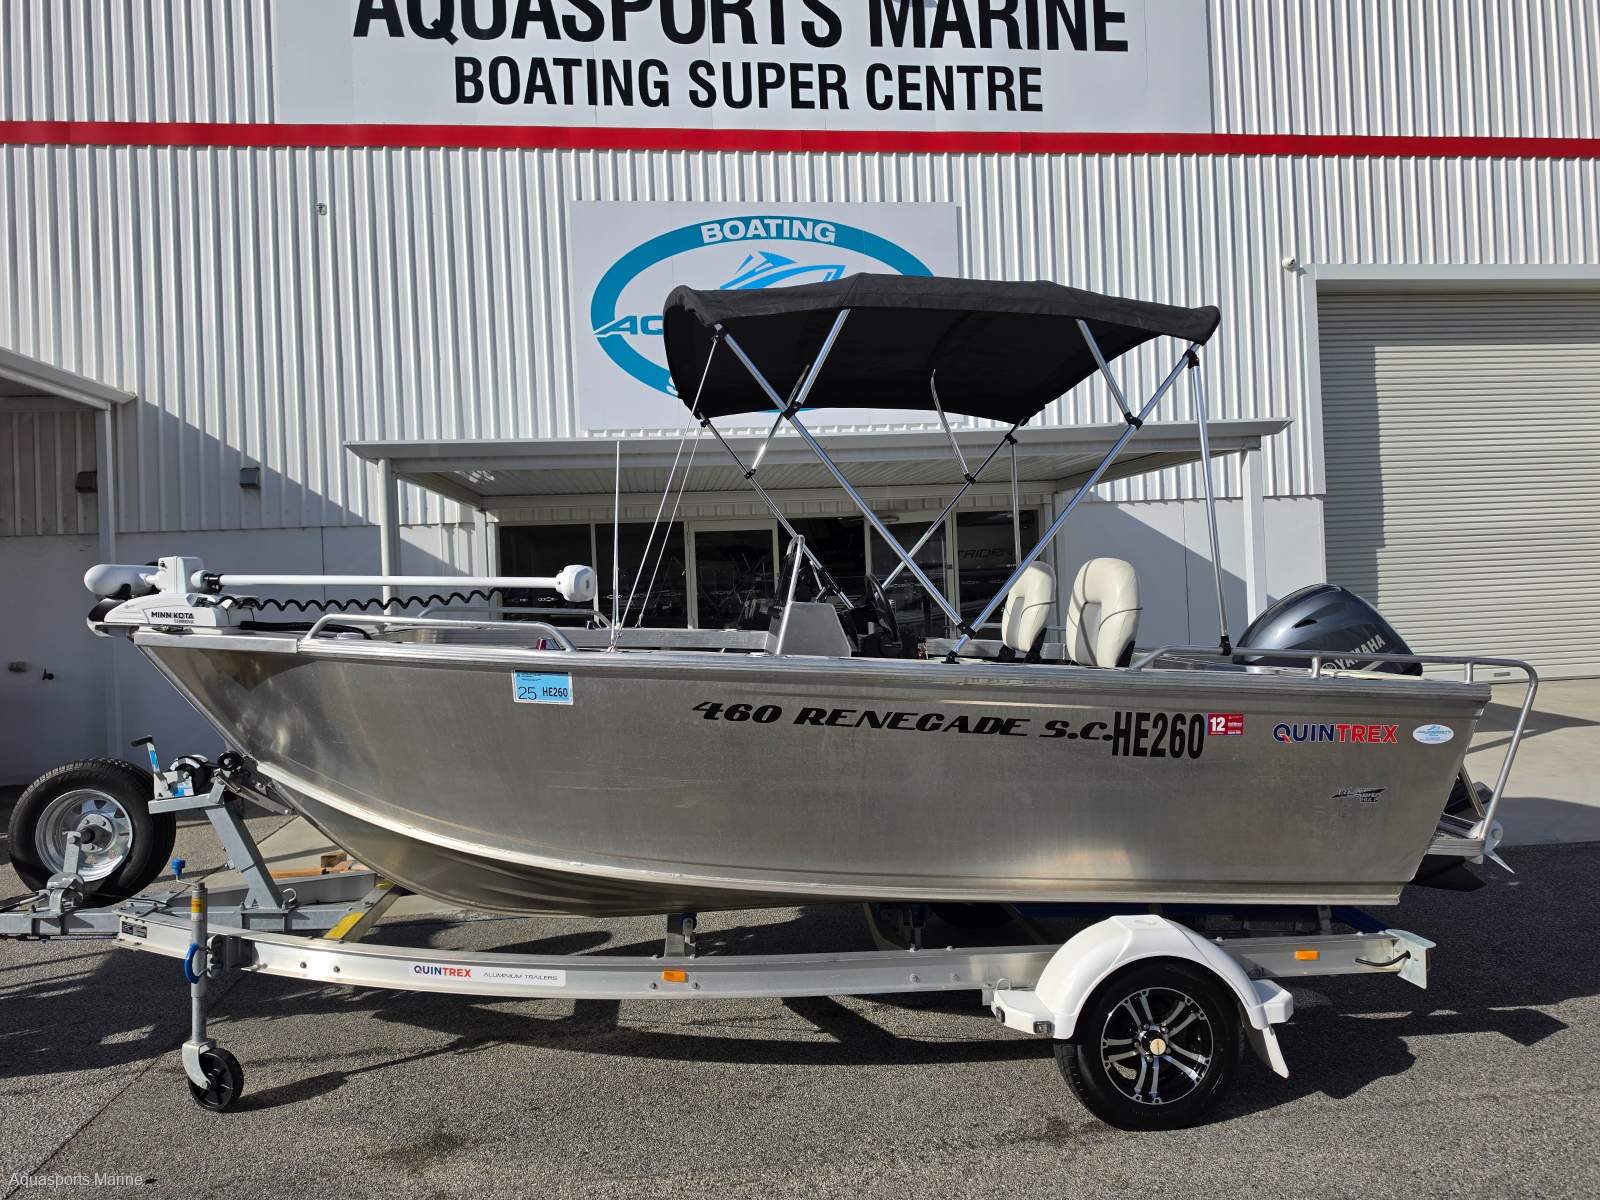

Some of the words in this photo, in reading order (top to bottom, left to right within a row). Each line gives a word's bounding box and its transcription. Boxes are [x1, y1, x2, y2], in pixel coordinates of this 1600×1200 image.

[353, 0, 843, 48] AQUASPORTS
[869, 0, 1129, 52] MARINE
[455, 56, 670, 107] BOATING
[688, 59, 850, 110] SUPER
[866, 62, 1043, 112] CENTRE
[701, 218, 837, 243] BOATING
[151, 611, 172, 619] MINN
[173, 612, 195, 620] KOTA
[518, 686, 537, 700] 25
[542, 687, 569, 697] HE260
[692, 701, 783, 724] 460
[792, 707, 1031, 737] RENEGADE
[1210, 716, 1226, 732] 12
[1111, 711, 1205, 759] HE260
[1272, 722, 1400, 744] QUINTREX
[414, 965, 472, 978] QUINTREX
